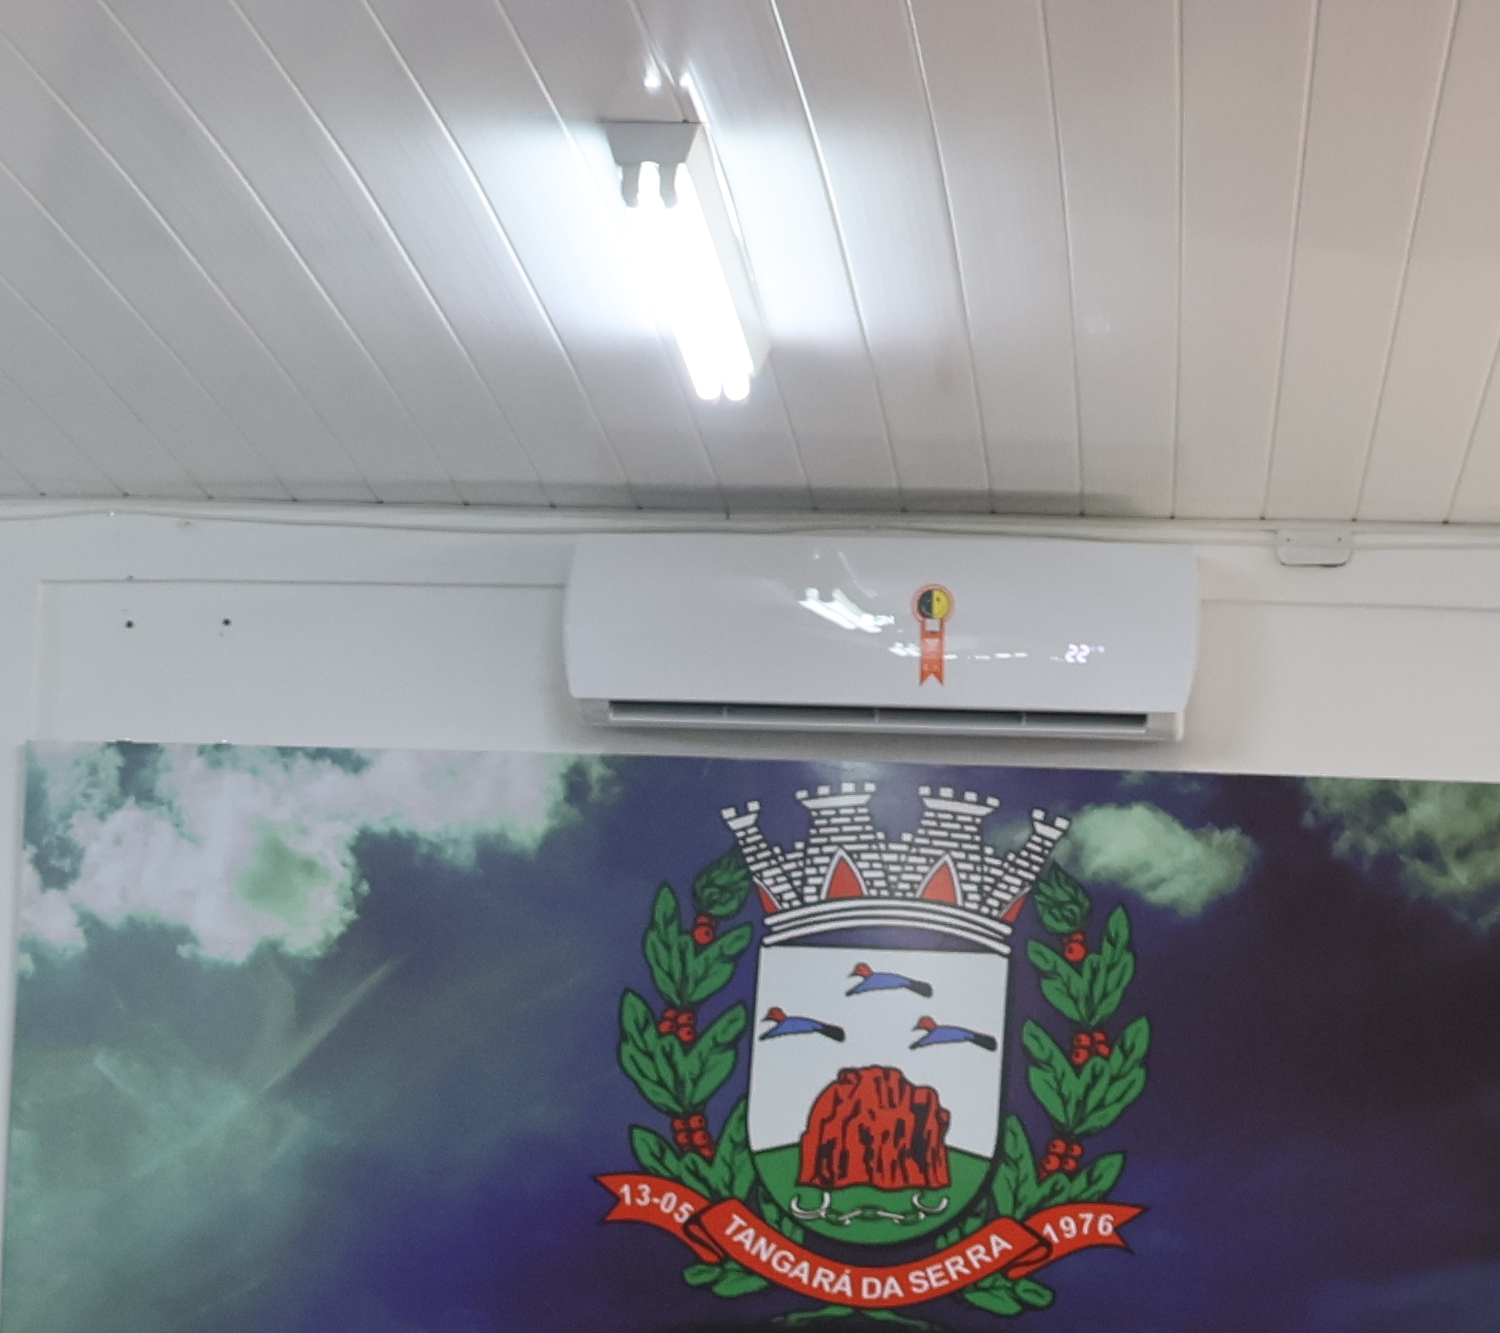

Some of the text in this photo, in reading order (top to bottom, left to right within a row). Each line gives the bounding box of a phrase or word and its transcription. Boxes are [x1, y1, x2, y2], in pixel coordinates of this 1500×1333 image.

[618, 1184, 695, 1226] 13-05
[1042, 1212, 1114, 1247] 1976
[723, 1213, 1014, 1300] TANGARÁ DA SERRA
